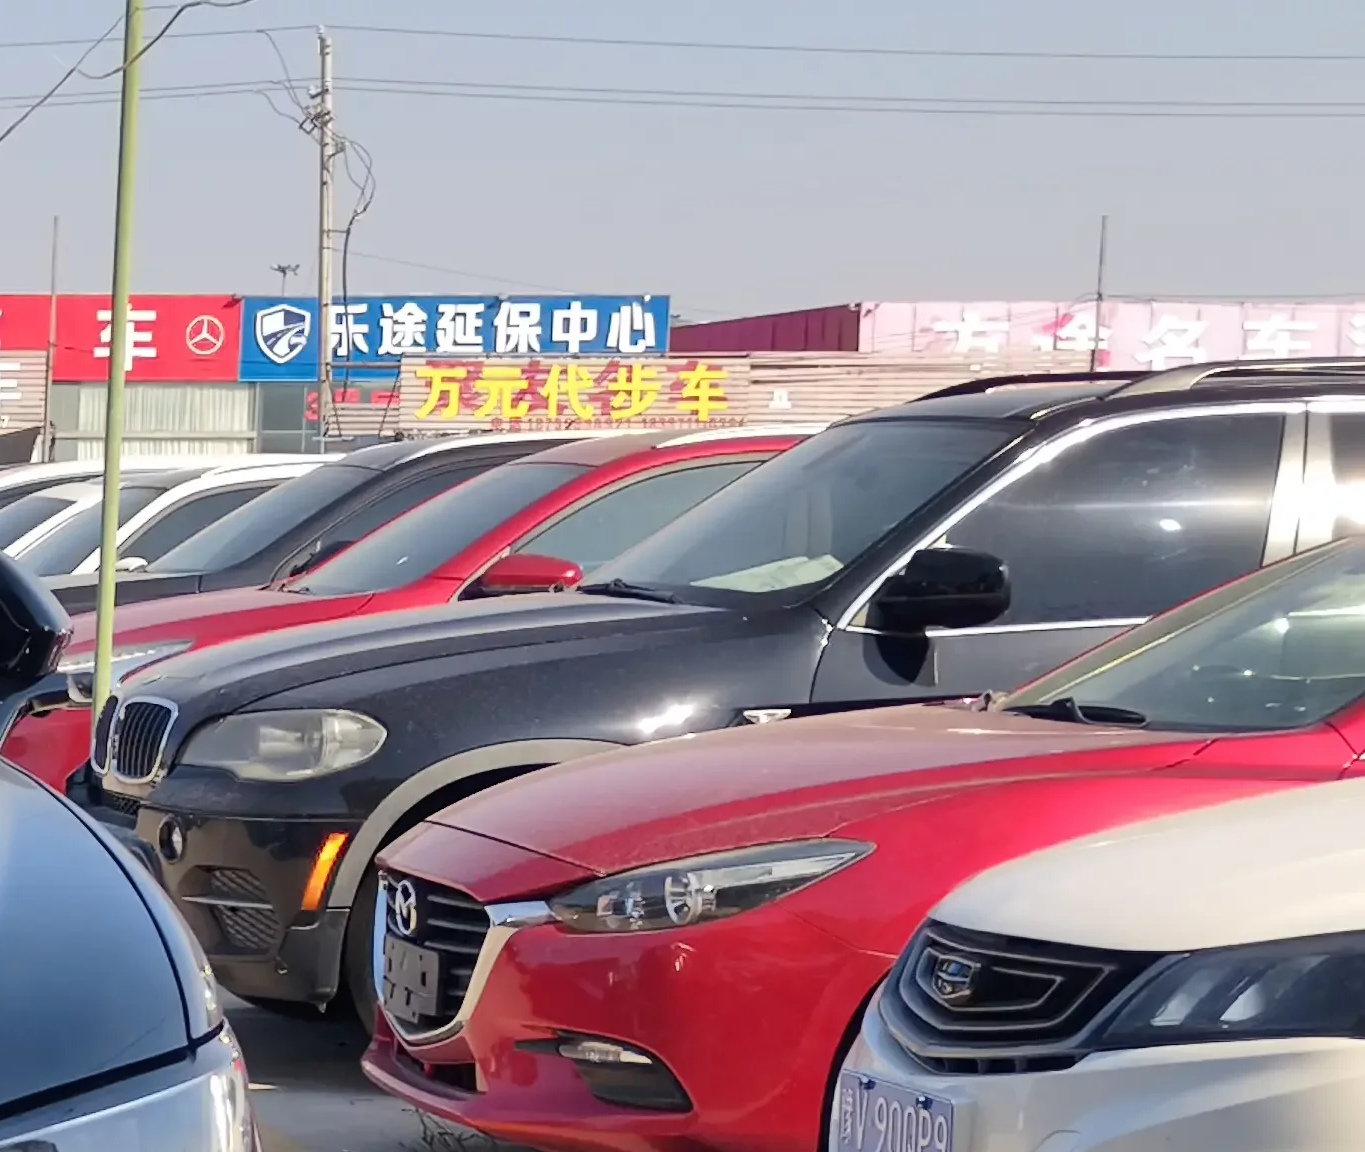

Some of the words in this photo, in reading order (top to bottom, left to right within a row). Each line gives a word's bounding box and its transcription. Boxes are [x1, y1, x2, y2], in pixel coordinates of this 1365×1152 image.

[329, 296, 656, 356] 乐途延保中心
[415, 363, 729, 421] 万元代步车
